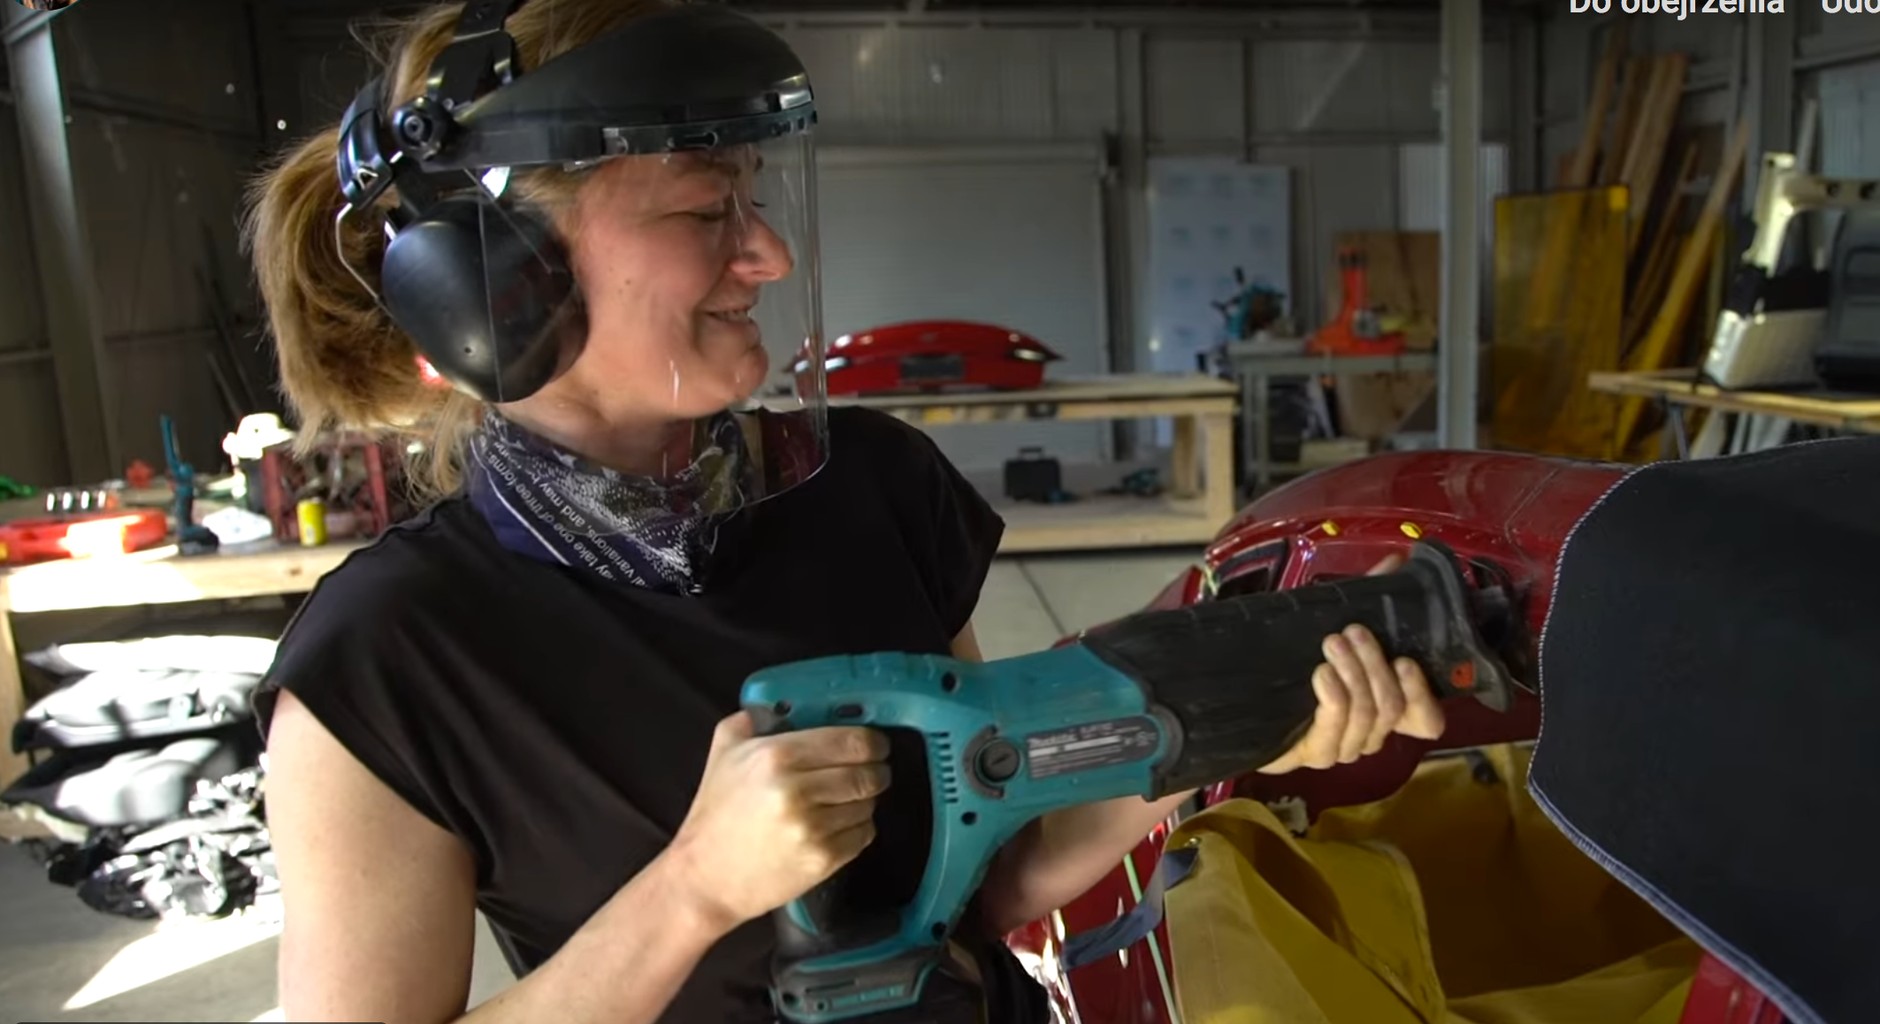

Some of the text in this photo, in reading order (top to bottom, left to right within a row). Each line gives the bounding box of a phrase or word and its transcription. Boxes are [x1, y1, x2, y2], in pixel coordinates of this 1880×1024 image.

[515, 483, 544, 514] three
[540, 483, 564, 507] may
[538, 511, 555, 524] of
[561, 505, 585, 527] and
[553, 522, 575, 543] one
[573, 541, 599, 567] take
[586, 524, 635, 579] variations,
[595, 563, 617, 581] ay
